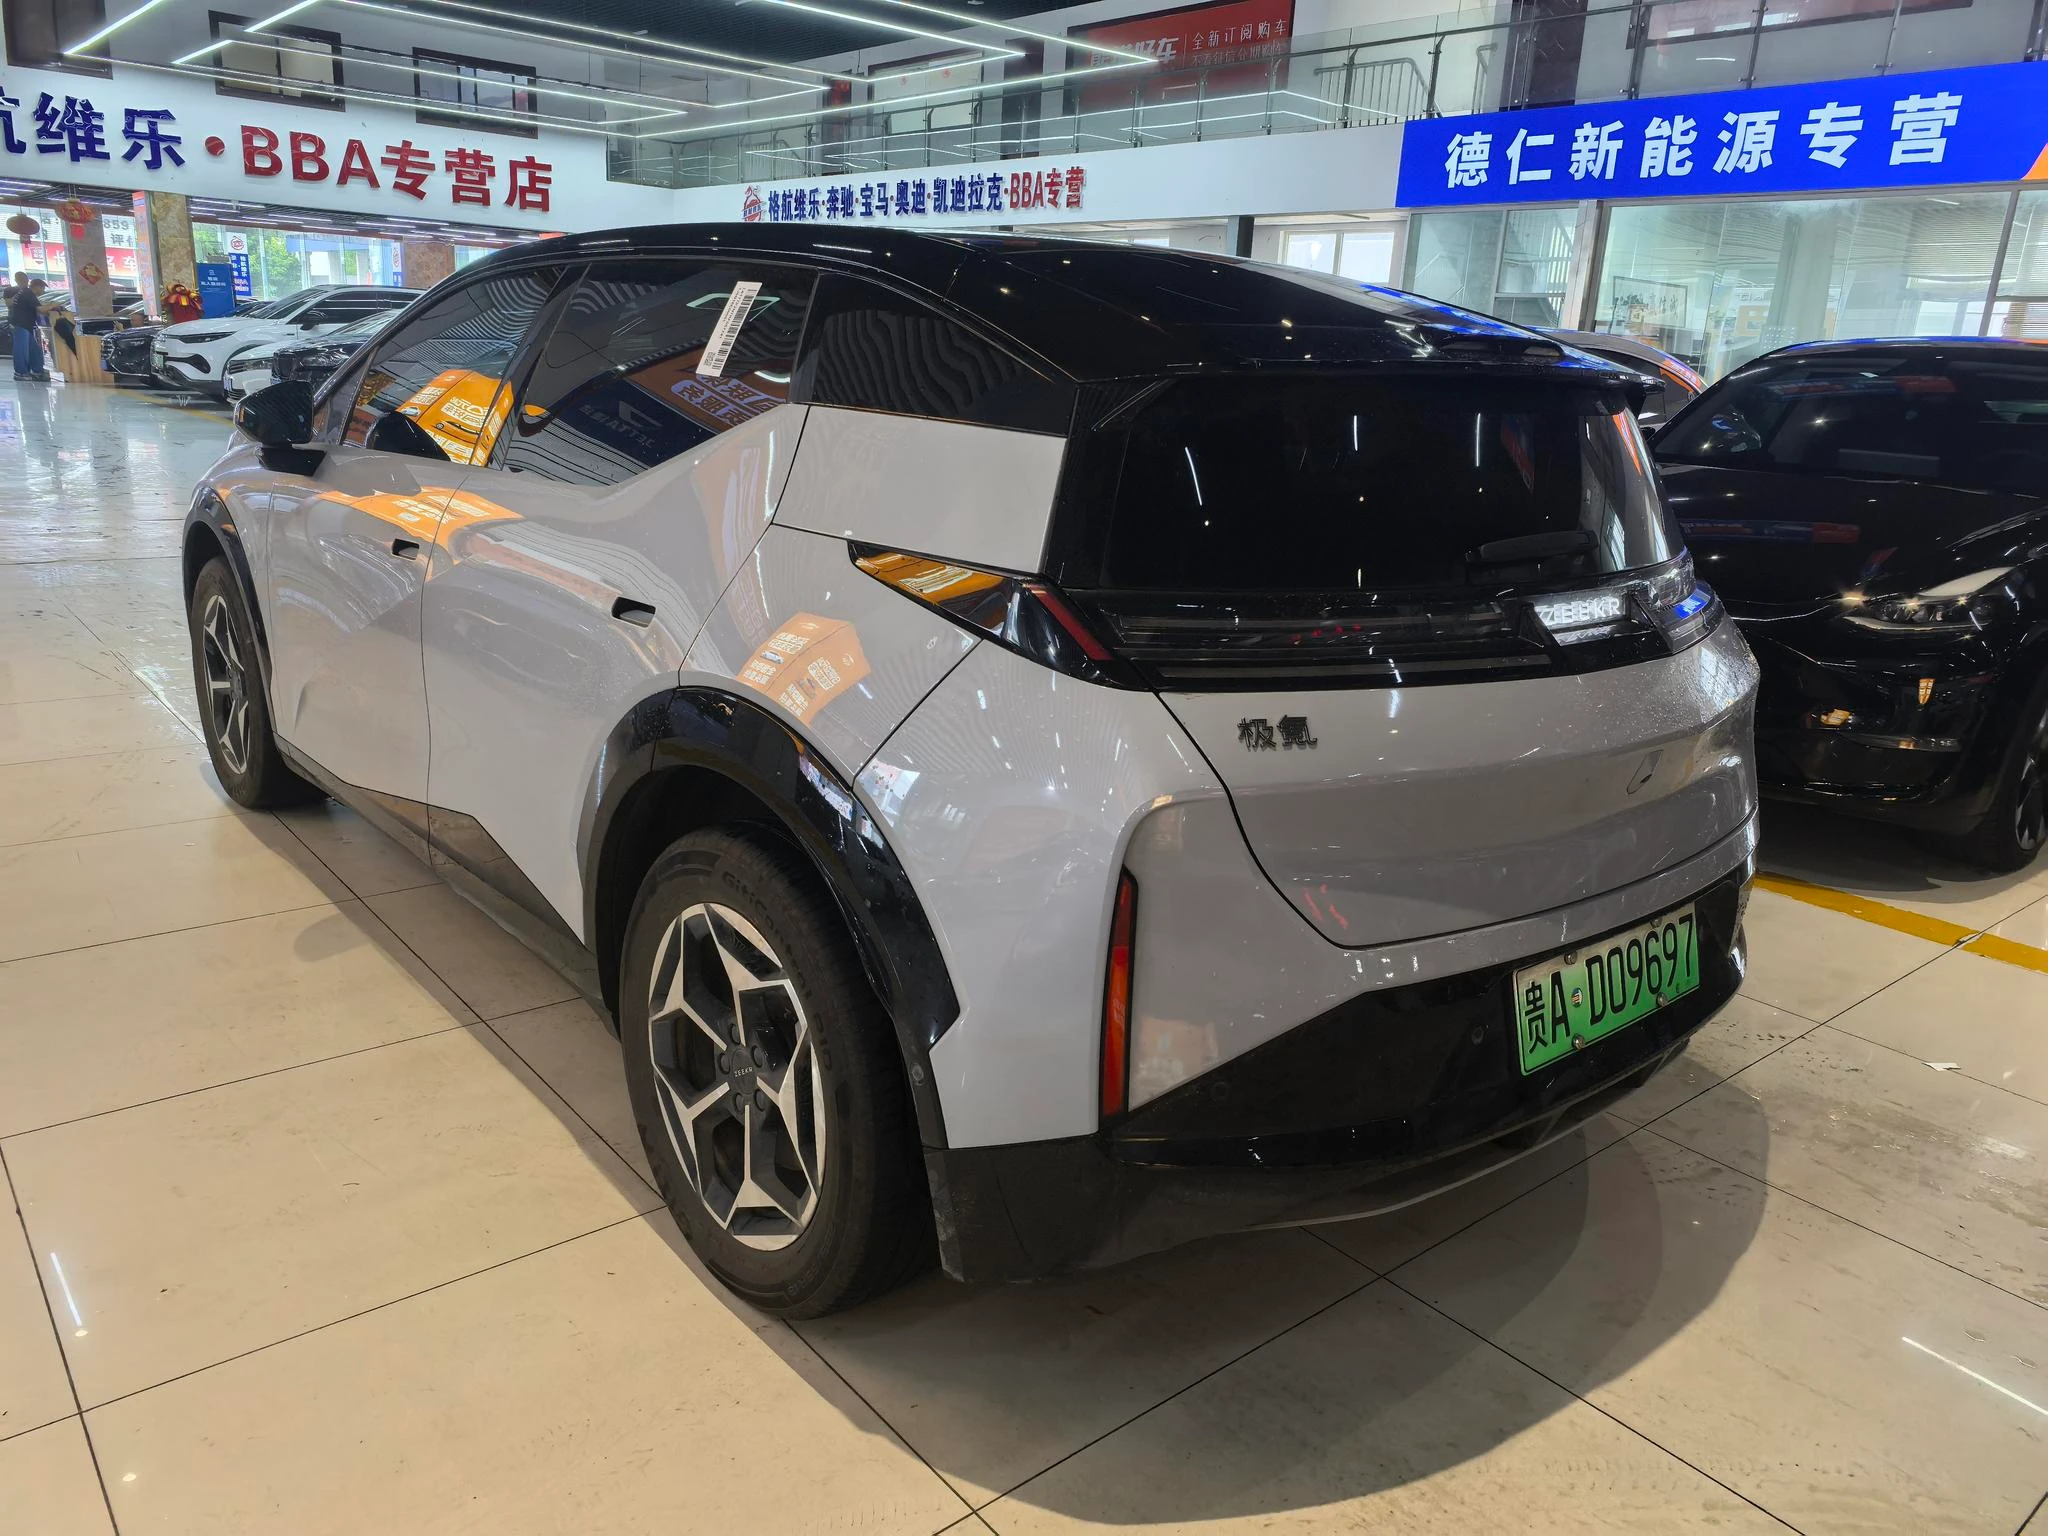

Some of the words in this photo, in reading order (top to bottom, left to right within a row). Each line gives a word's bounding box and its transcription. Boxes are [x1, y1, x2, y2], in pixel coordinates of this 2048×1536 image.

[1192, 19, 1286, 50] 全新订阅购车
[1445, 92, 1963, 189] 德仁新能源专营
[1237, 714, 1318, 748] 极氪
